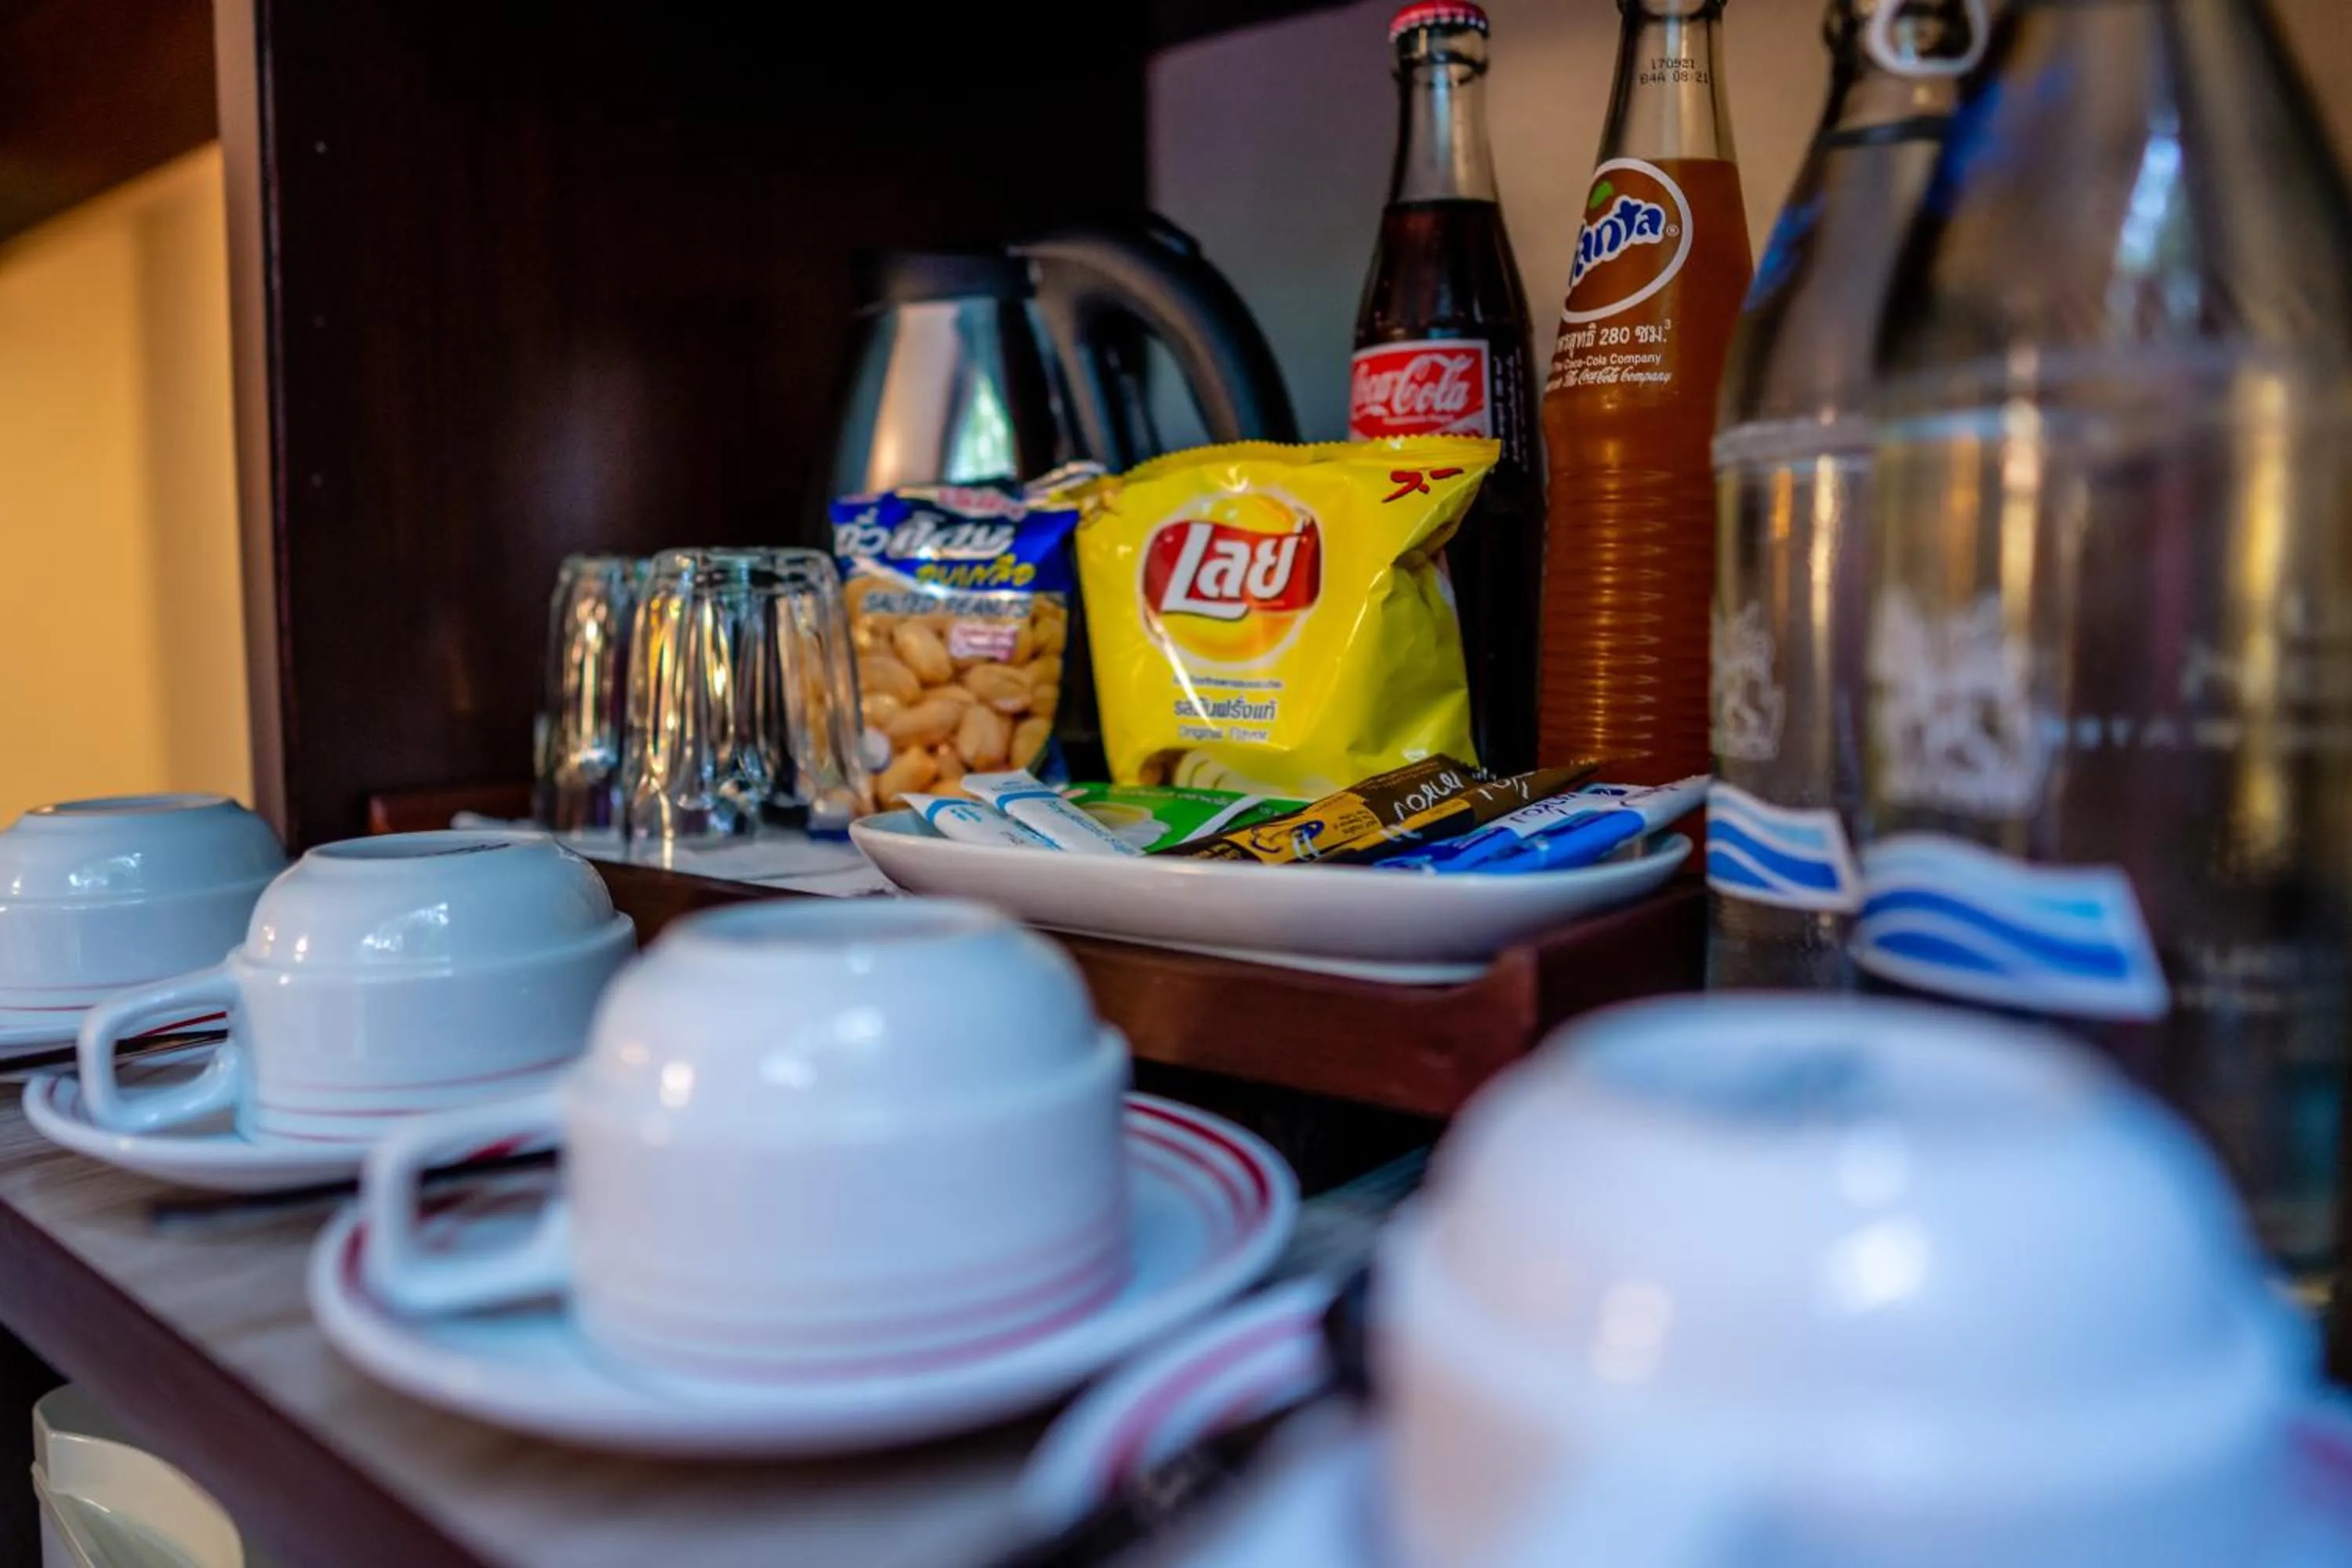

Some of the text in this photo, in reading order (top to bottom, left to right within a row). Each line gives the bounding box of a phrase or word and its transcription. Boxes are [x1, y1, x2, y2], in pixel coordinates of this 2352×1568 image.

[1570, 196, 1664, 287] anta
[1599, 326, 1630, 346] 280
[1610, 353, 1662, 367] Company
